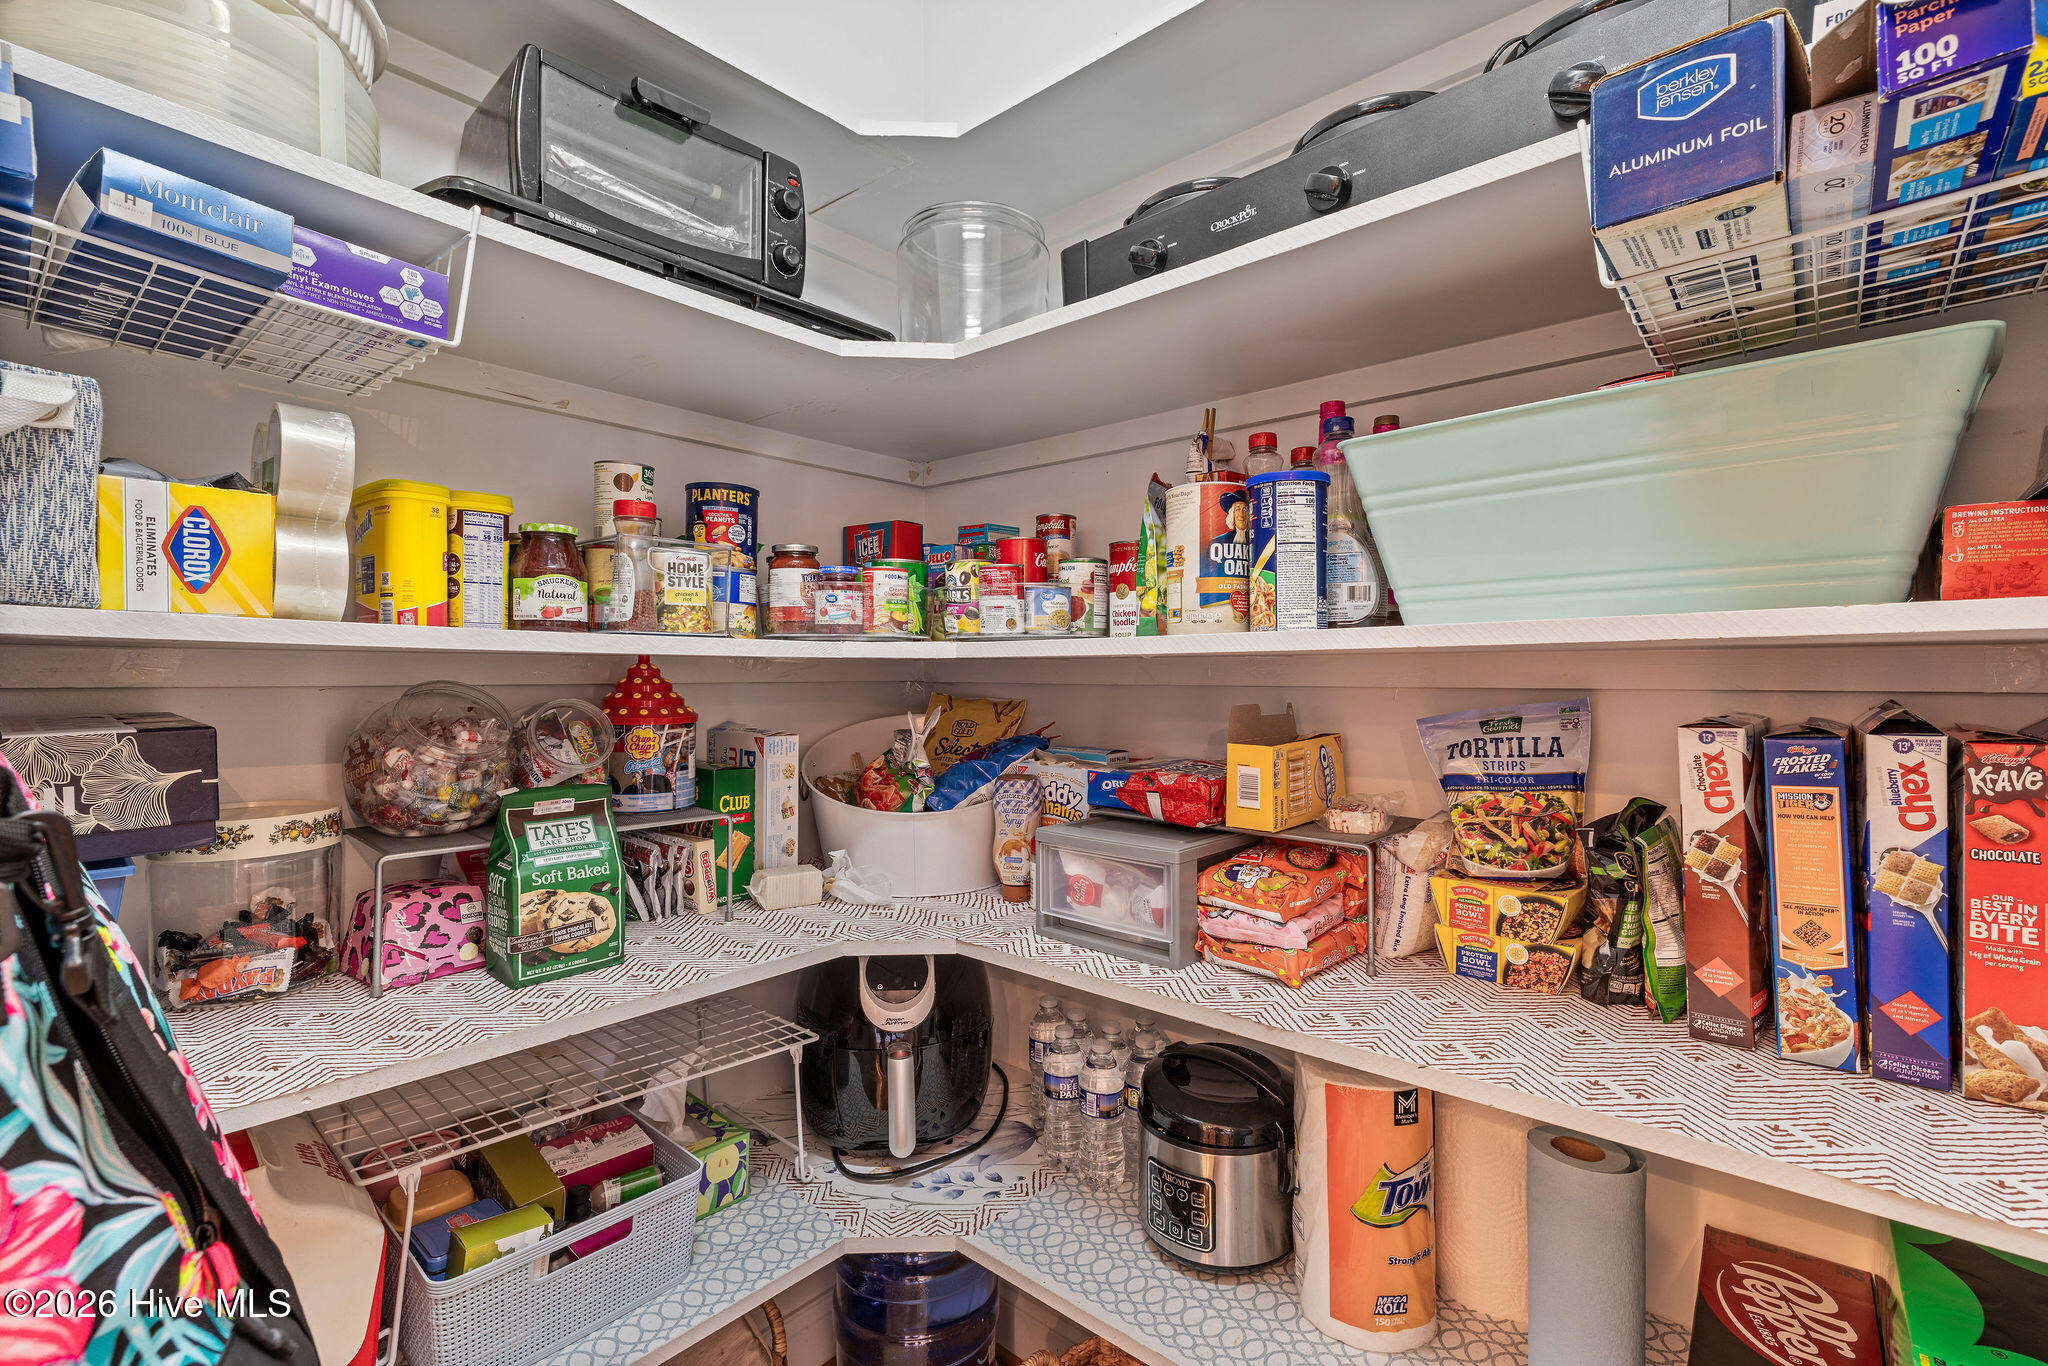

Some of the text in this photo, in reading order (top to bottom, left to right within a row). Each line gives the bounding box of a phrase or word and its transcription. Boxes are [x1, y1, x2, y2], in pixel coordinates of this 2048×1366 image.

[1895, 7, 1956, 38] Paper
[1896, 33, 1959, 74] 100
[1897, 53, 1958, 84] SQ FT
[1656, 64, 1719, 96] berkley
[1829, 112, 1846, 135] 20
[1859, 100, 1872, 156] ALUMINUM FOIL
[1608, 116, 1768, 179] ALUMINUM FOIL
[138, 175, 265, 234] Montclair
[160, 217, 239, 252] 100s BLUE
[311, 277, 375, 303] Exam Gloves
[305, 285, 383, 312] NITRILE BLEND FORMULATION
[307, 291, 321, 300] FREE
[327, 297, 339, 305] NON
[691, 488, 750, 506] PLANTERS
[464, 511, 489, 519] Nutrition
[1952, 505, 2048, 519] BREWING INSTRUCTIONS
[705, 516, 736, 524] PEANUTS
[135, 499, 144, 592] FOOD BACTERIAL ODORS
[146, 516, 157, 576] ELIMINATES
[182, 516, 211, 583] CLOROX
[857, 535, 879, 557] ICEE
[667, 562, 704, 574] HOME
[667, 576, 705, 588] STYLE
[538, 589, 577, 601] Natural
[1112, 610, 1137, 618] Chicken
[1113, 618, 1136, 626] Noodle
[955, 719, 975, 729] ROLD
[1482, 722, 1521, 733] Gourmet
[630, 734, 657, 744] Chupa
[954, 727, 975, 738] GOLD
[629, 742, 656, 752] Chups
[1447, 736, 1564, 760] TORTILLA
[1483, 761, 1526, 771] STRIPS
[1772, 754, 1832, 767] FROSTED
[1981, 753, 2028, 767] Kellogg's
[1693, 755, 1707, 792] Chocolate
[1776, 763, 1827, 775] FLAKES
[1320, 745, 1333, 808] OREO
[1702, 749, 1735, 814] Chex
[1887, 768, 1902, 806] Blueberry
[1777, 792, 1814, 801] MISSION
[1897, 759, 1937, 832] Chex
[719, 794, 751, 813] CLUB
[1000, 803, 1029, 815] Sundae
[1778, 800, 1815, 810] TIGER
[1003, 813, 1025, 828] Syrup
[529, 820, 592, 842] TATE'S
[540, 835, 588, 848] BAKE SHOP
[1970, 848, 2042, 865] CHOCOLATE
[531, 862, 611, 887] Soft Baked
[488, 872, 507, 897] SOFT
[1473, 888, 1486, 898] BITE
[1992, 894, 2014, 903] OUR
[1400, 893, 1408, 910] Long
[1454, 902, 1486, 913] PROTEIN
[1970, 898, 2038, 915] BEST IN
[1456, 909, 1484, 920] BOWL
[1793, 905, 1818, 913] MISSION
[1970, 909, 2038, 927] EVERY
[568, 922, 593, 934] CHOCOLATE
[1395, 911, 1406, 941] Enriched
[554, 928, 591, 943] CHUNK COOKIES
[1969, 921, 2040, 946] BITE
[1393, 939, 1401, 952] Rice
[1479, 936, 1492, 946] BITE
[1461, 949, 1493, 960] PROTEIN
[1985, 945, 2024, 955] Made with
[1462, 955, 1491, 967] BOWL
[1968, 950, 2042, 966] 14g of Whole Grain
[1984, 960, 2025, 972] per serving
[1904, 1009, 1930, 1018] Vitamins
[1904, 1015, 1930, 1024] Minerals
[1701, 1020, 1744, 1032] Celiac Disease
[1701, 1026, 1744, 1037] FOUNDATION
[1888, 1060, 1940, 1075] Celiac Disease
[1888, 1066, 1940, 1080] FOUNDATION
[584, 1119, 623, 1136] BRAZIL
[294, 1143, 322, 1168] Little
[1162, 1171, 1190, 1189] AROMA
[1388, 1256, 1416, 1266] Strong
[1377, 1295, 1407, 1305] MEGA
[1375, 1302, 1407, 1315] ROLL
[1733, 1261, 1859, 1360] Dr
[1374, 1317, 1391, 1326] 150
